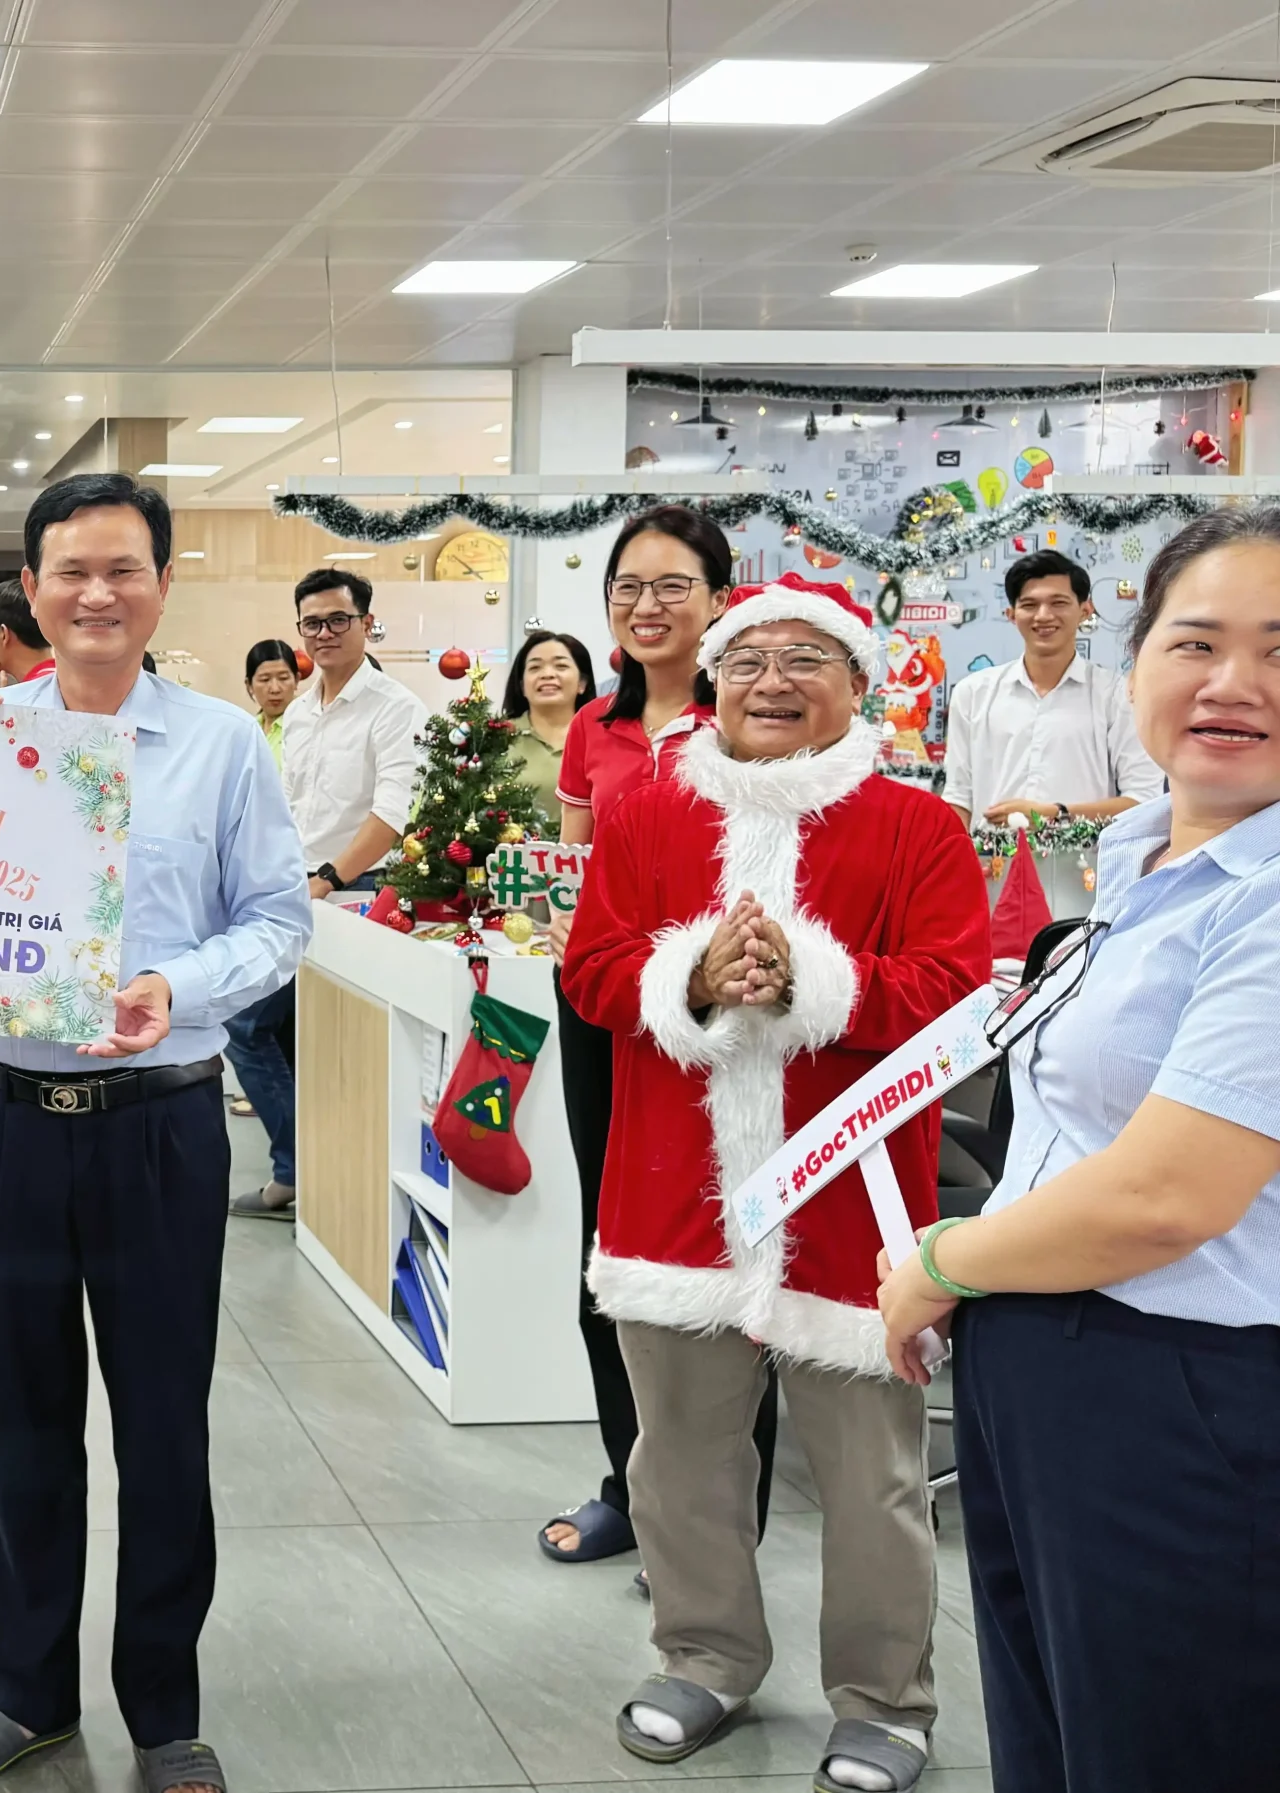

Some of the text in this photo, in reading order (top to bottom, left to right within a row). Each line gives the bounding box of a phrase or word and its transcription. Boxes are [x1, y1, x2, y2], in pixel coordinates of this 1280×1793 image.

[28, 913, 63, 932] GIÁ
[484, 1096, 502, 1125] 1
[791, 1062, 935, 1194] #GocTHIBIDI
